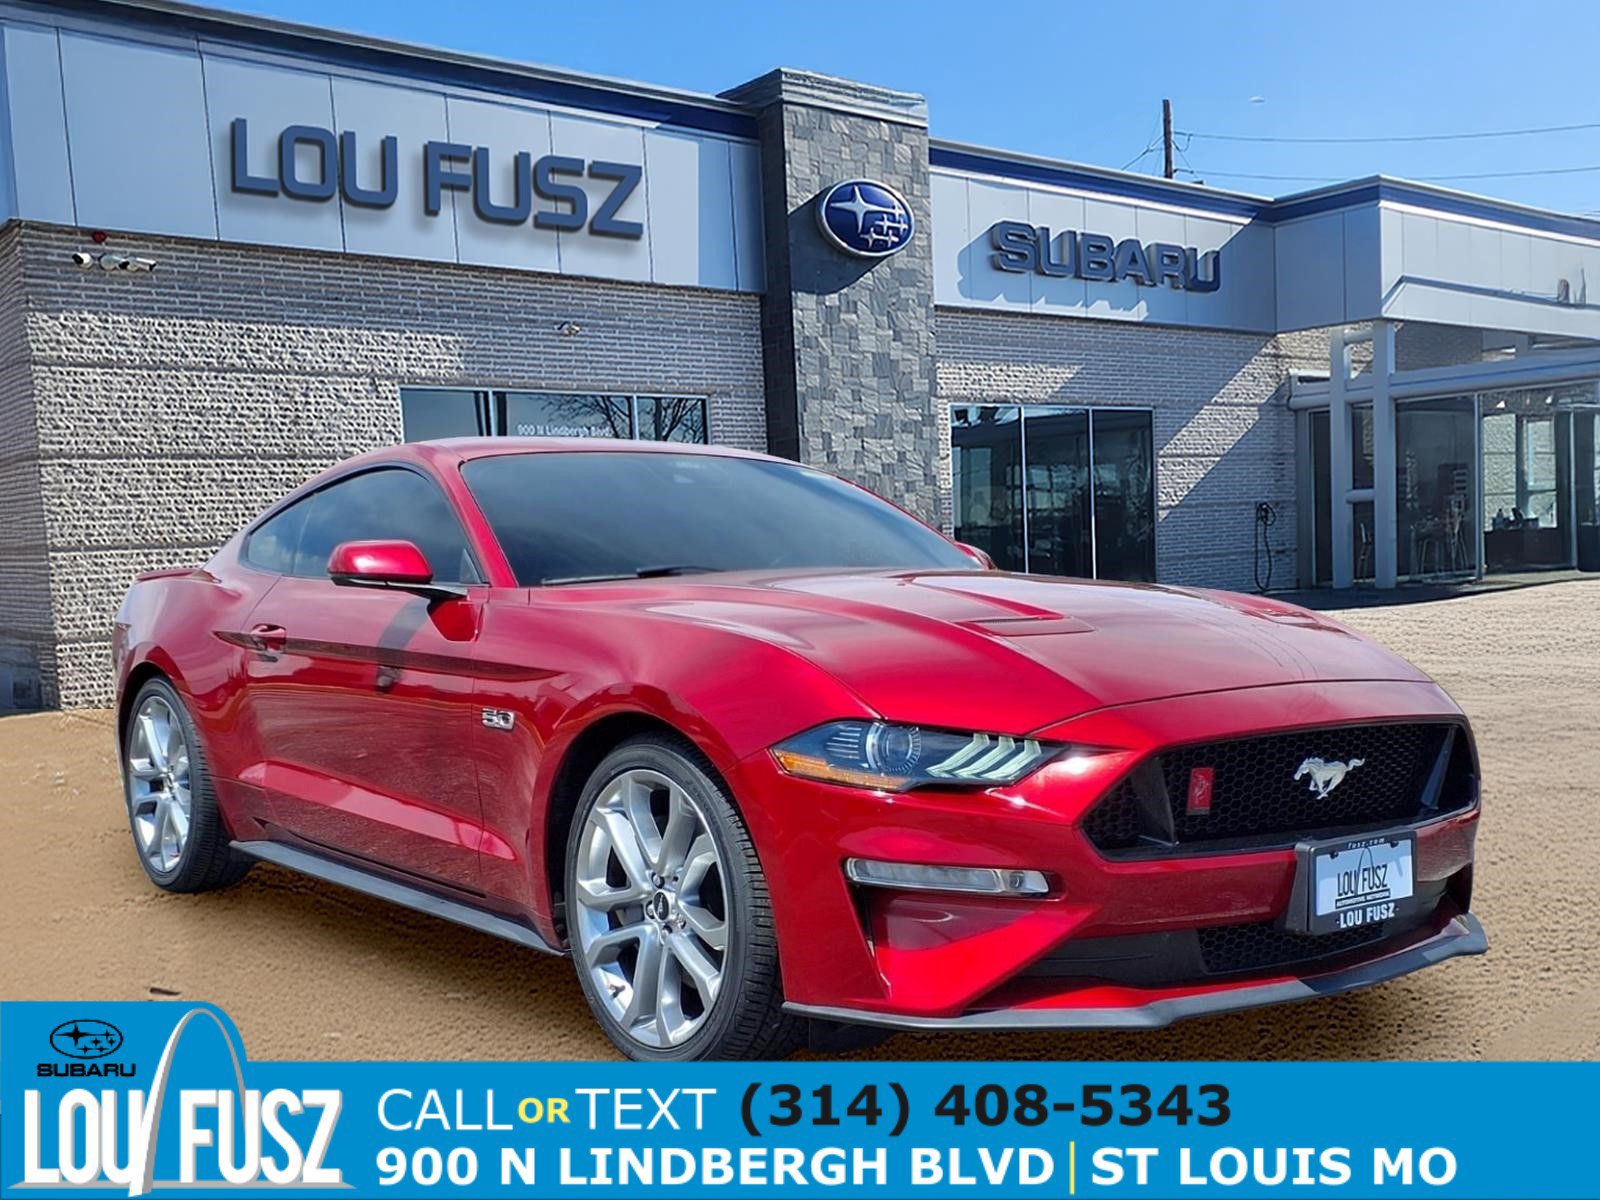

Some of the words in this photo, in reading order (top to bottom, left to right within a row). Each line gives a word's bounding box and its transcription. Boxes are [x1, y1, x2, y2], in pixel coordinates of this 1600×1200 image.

[231, 117, 398, 209] LOU
[424, 140, 644, 240] FUSZ
[990, 220, 1221, 293] SUBARU
[1337, 870, 1359, 897] LOU
[1362, 864, 1387, 892] FUSZ
[1340, 909, 1363, 928] LOU
[1366, 902, 1395, 922] FUSZ
